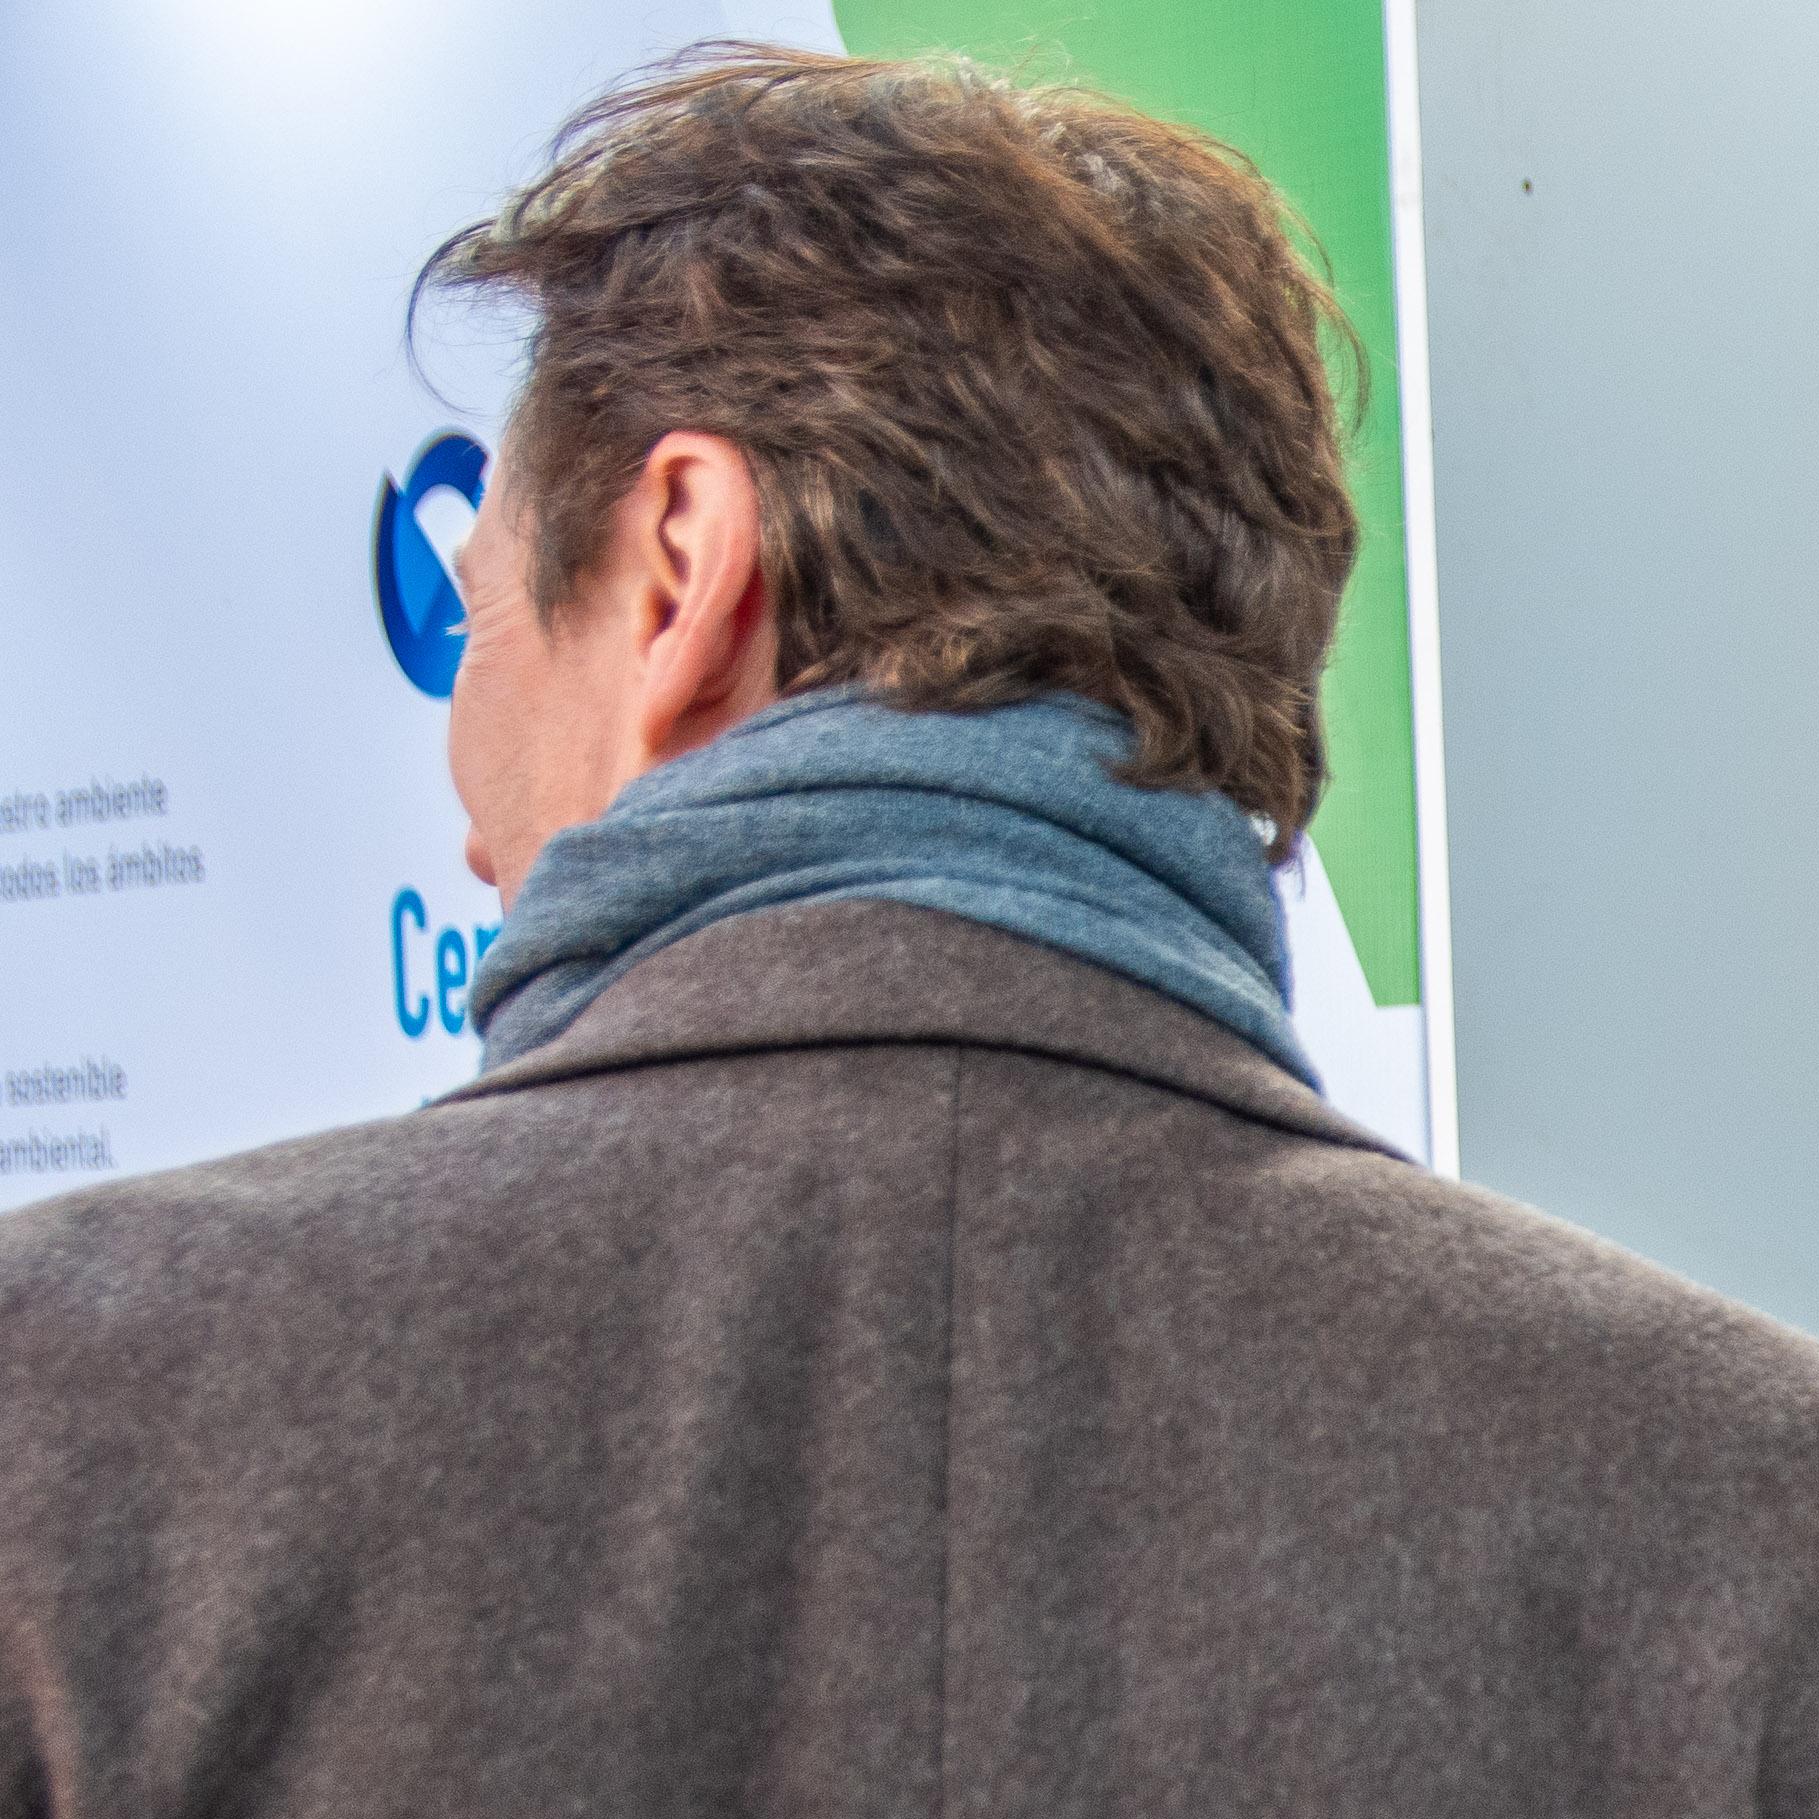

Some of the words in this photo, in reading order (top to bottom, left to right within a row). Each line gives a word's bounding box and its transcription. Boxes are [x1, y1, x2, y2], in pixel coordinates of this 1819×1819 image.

[54, 771, 168, 828] ambiente
[62, 846, 101, 895] los
[390, 887, 502, 1037] Ce
[4, 1054, 128, 1106] sostenible
